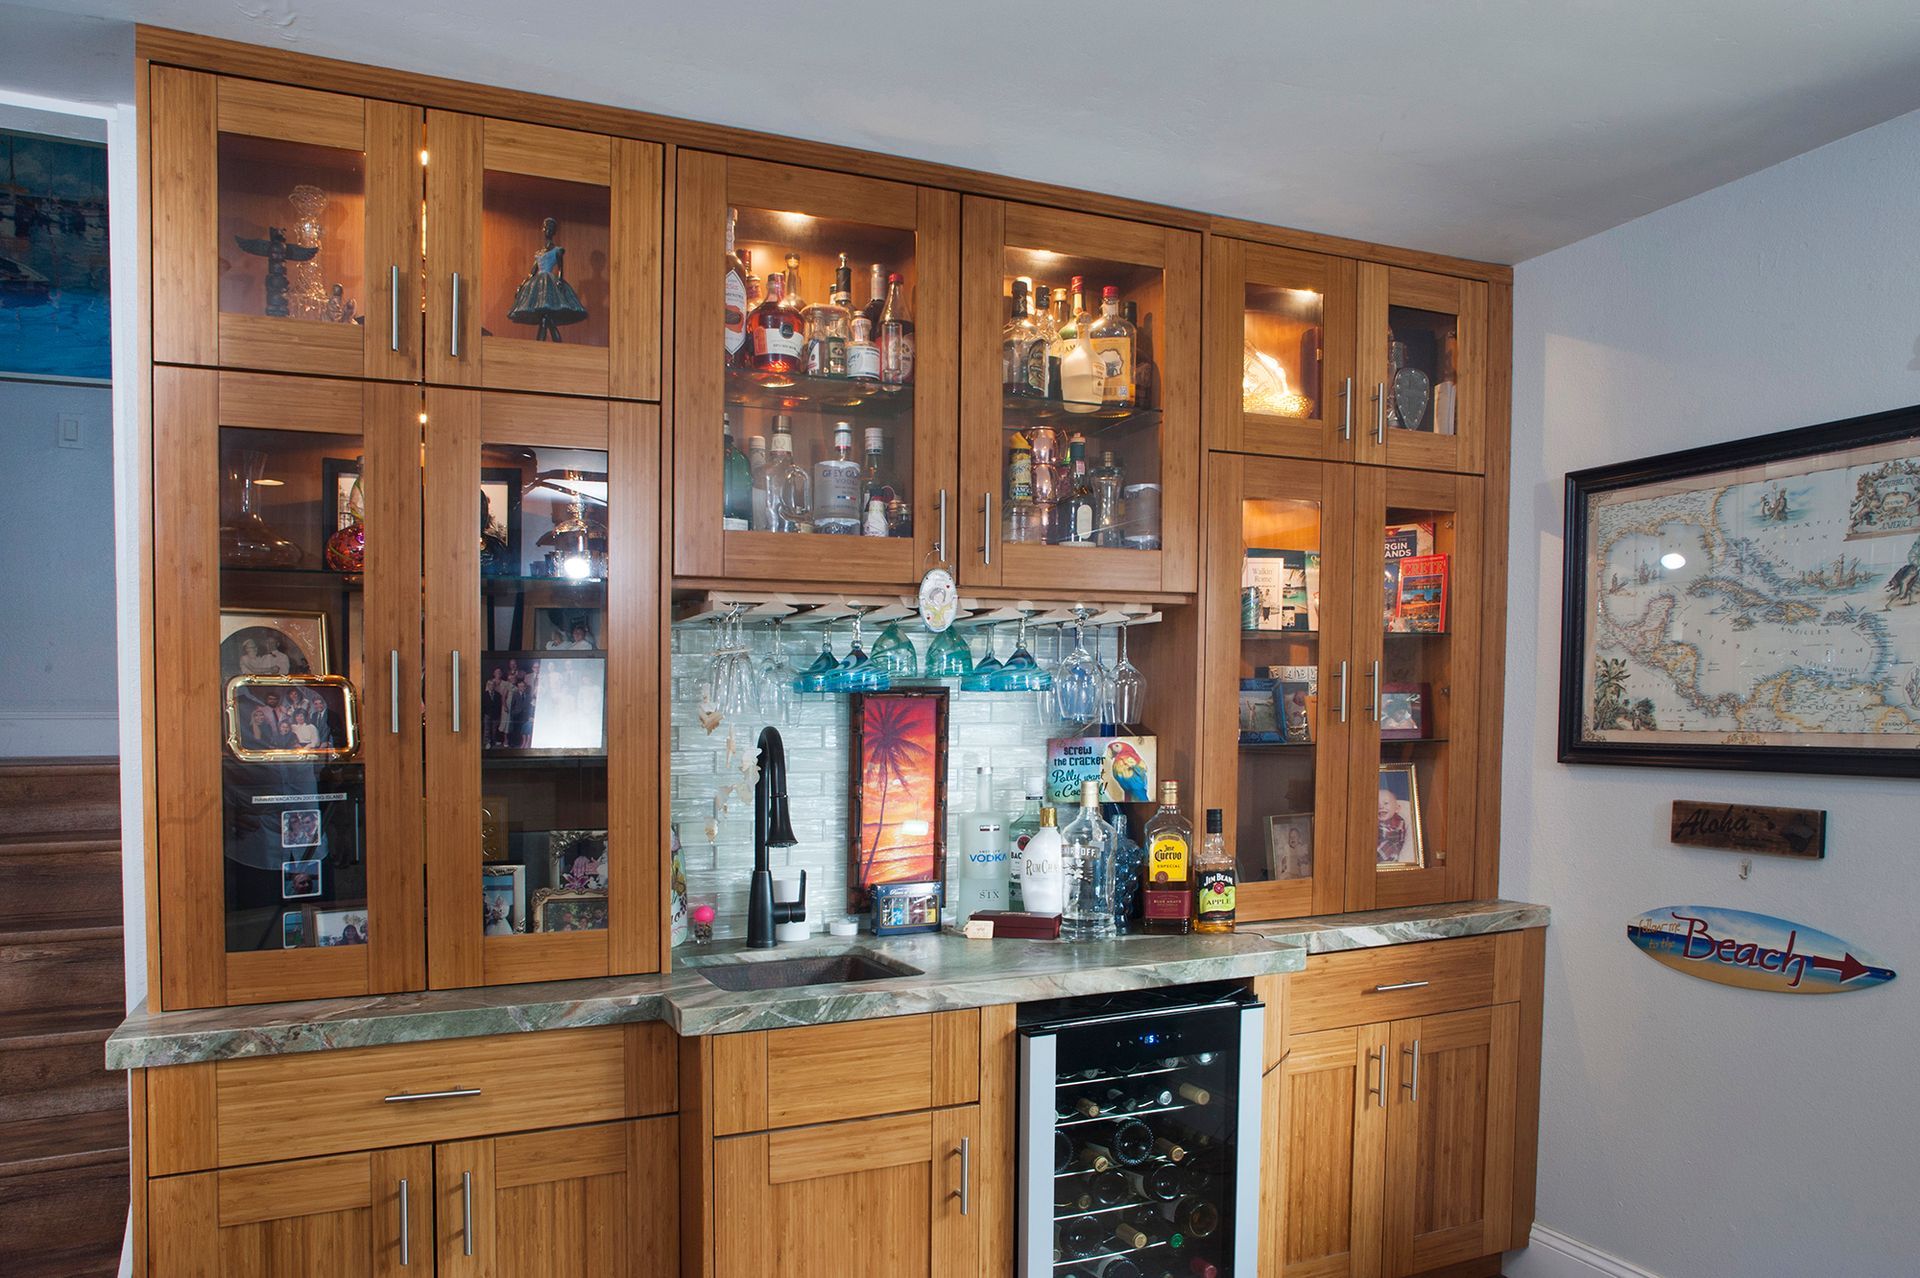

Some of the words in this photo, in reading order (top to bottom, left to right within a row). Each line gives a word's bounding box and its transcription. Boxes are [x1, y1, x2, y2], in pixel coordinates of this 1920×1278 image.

[1384, 542, 1409, 551] RGIN
[1384, 549, 1413, 559] ANDS
[1054, 758, 1067, 766] the
[1675, 804, 1751, 838] Aloha
[969, 852, 1007, 863] VODKA
[1154, 849, 1182, 862] Cuervo
[1204, 875, 1216, 887] JIM
[1216, 872, 1234, 885] BEAM
[979, 890, 1000, 899] SIX
[1638, 919, 1667, 938] follow
[1649, 941, 1659, 950] to
[1660, 936, 1677, 950] the
[1672, 912, 1806, 988] Beach
